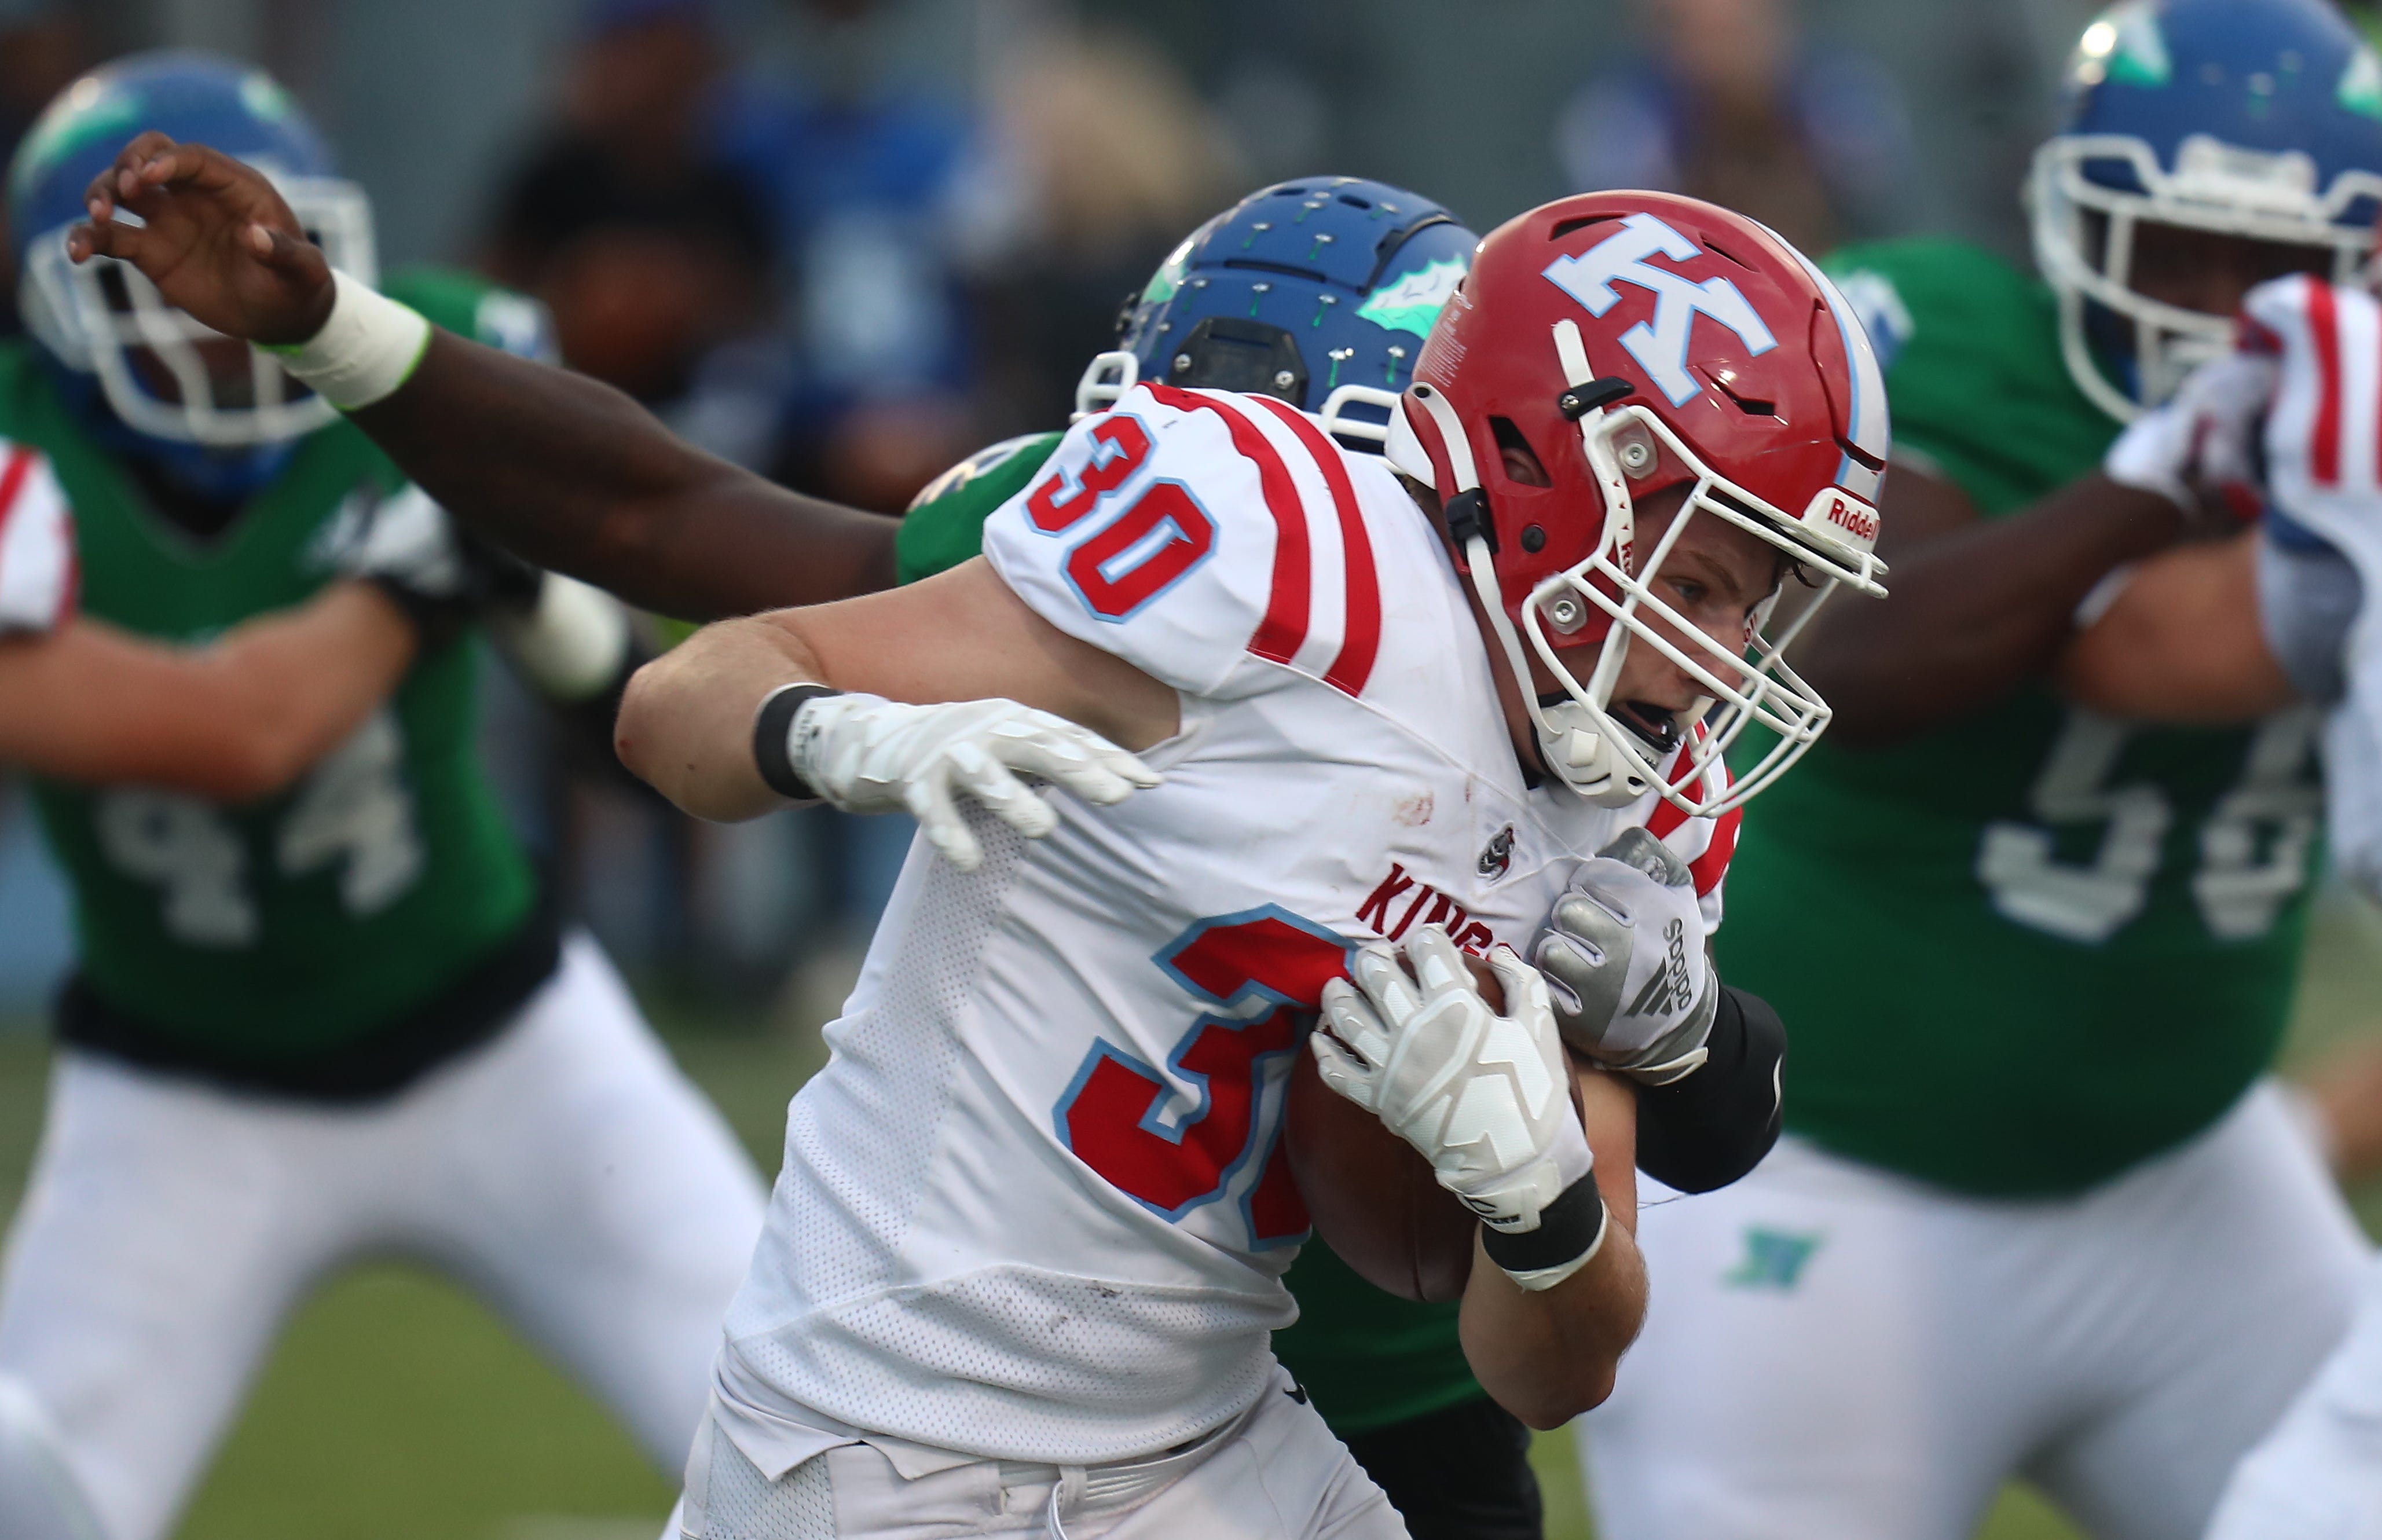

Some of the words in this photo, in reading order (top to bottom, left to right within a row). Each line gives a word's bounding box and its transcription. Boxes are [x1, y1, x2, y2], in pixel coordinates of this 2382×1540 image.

[1541, 212, 1778, 408] K
[1021, 412, 1220, 624] 30
[1356, 862, 1522, 962] KING
[1662, 917, 1692, 1011] adidas
[1053, 902, 1358, 1252] 3
